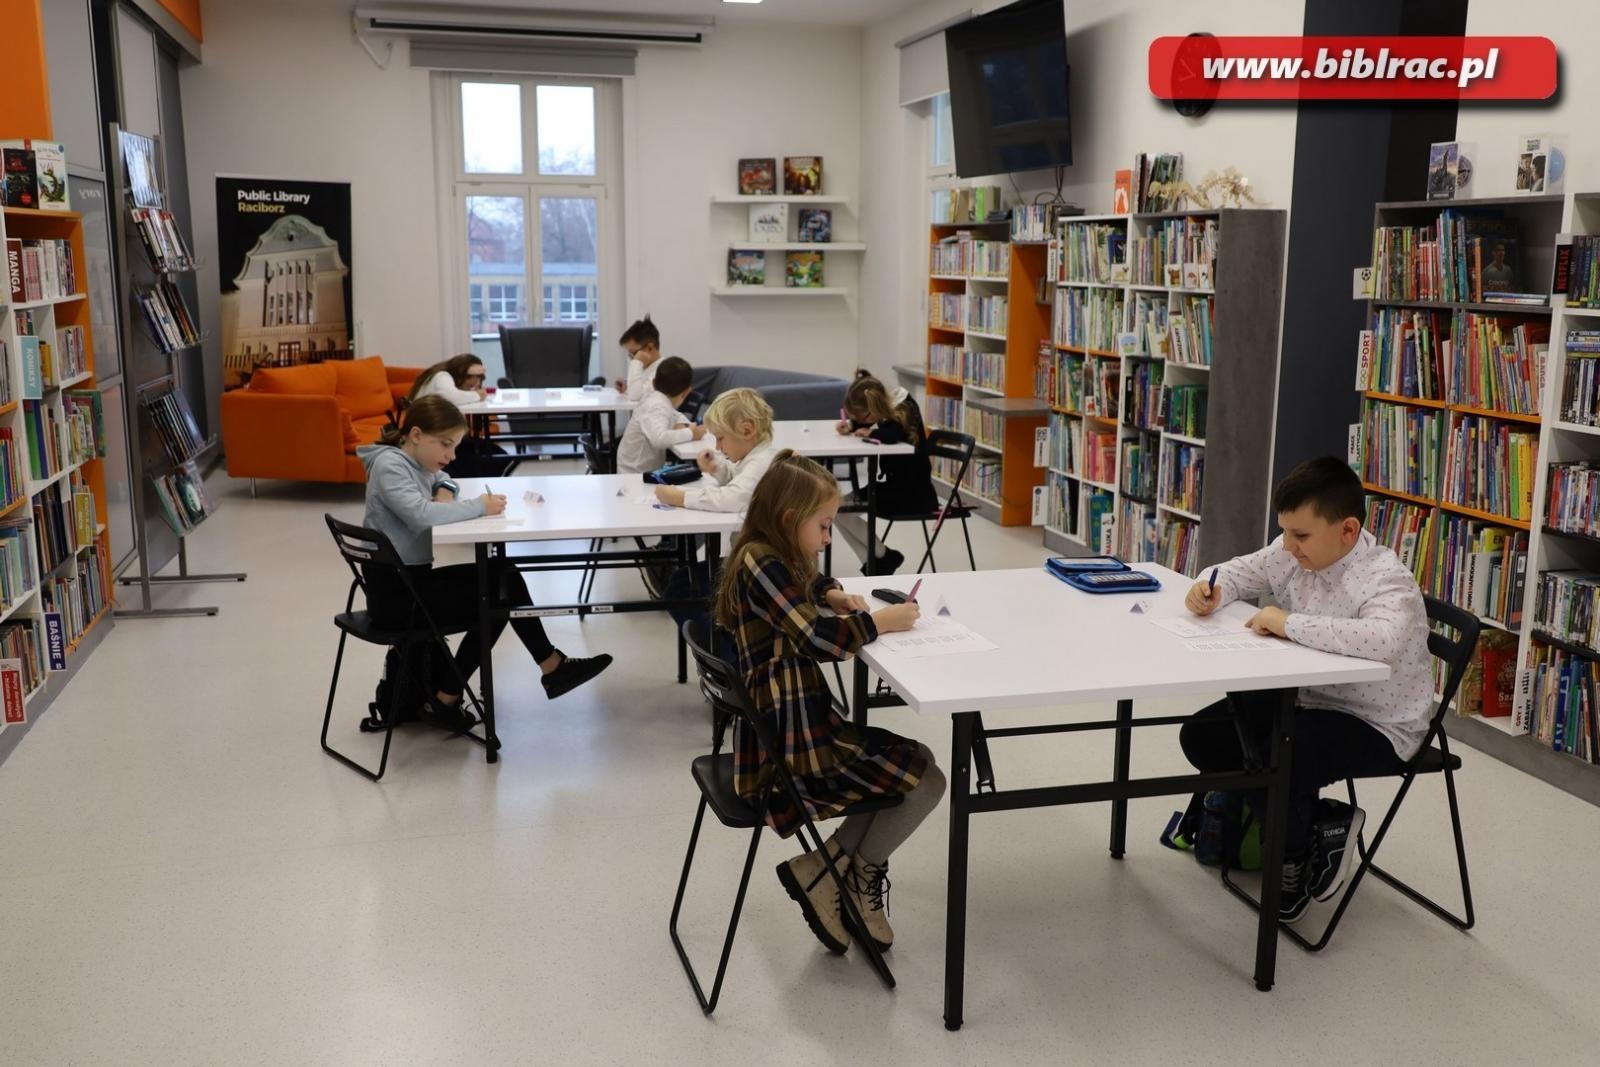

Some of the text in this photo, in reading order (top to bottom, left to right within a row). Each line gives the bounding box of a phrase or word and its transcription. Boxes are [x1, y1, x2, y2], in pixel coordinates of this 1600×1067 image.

[237, 190, 310, 205] Public Library
[237, 202, 286, 214] Raciborz
[8, 250, 20, 294] MANGA
[1557, 249, 1569, 290] NETFLIX
[26, 347, 36, 389] KOMIKSY
[1361, 333, 1371, 369] SPORT
[1104, 528, 1112, 555] NAUKA
[49, 620, 62, 659] BAŚNIE
[1523, 698, 1532, 731] ZABAWY
